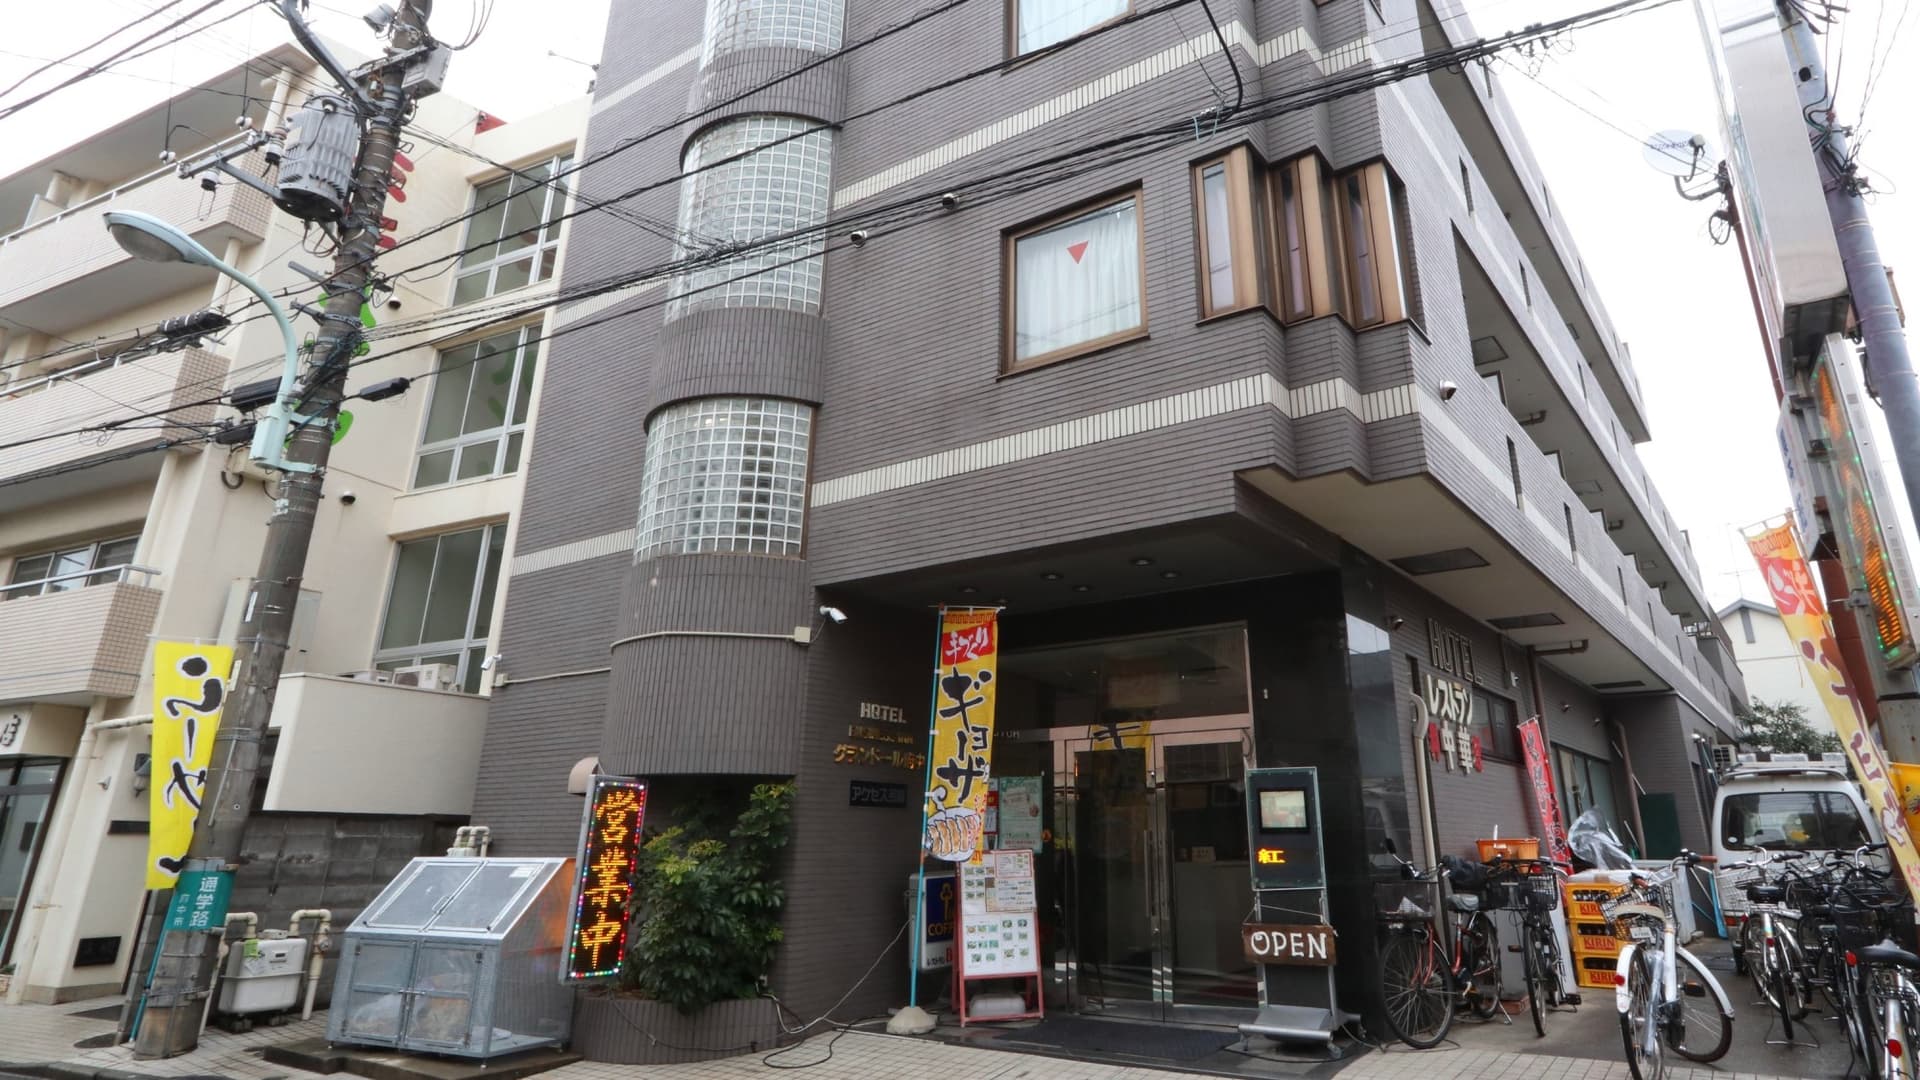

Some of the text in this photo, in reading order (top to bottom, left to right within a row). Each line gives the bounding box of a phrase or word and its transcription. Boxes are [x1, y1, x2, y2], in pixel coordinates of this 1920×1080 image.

[1427, 618, 1483, 686] HOTEL
[860, 702, 907, 724] HOTEL
[1427, 674, 1473, 725] レストラン
[936, 666, 993, 804] ギョーザ
[1441, 720, 1474, 774] 中華
[189, 876, 219, 927] 通学路
[580, 790, 640, 970] 営業中
[1250, 930, 1328, 959] OPEN
[1584, 937, 1616, 949] KIRIN
